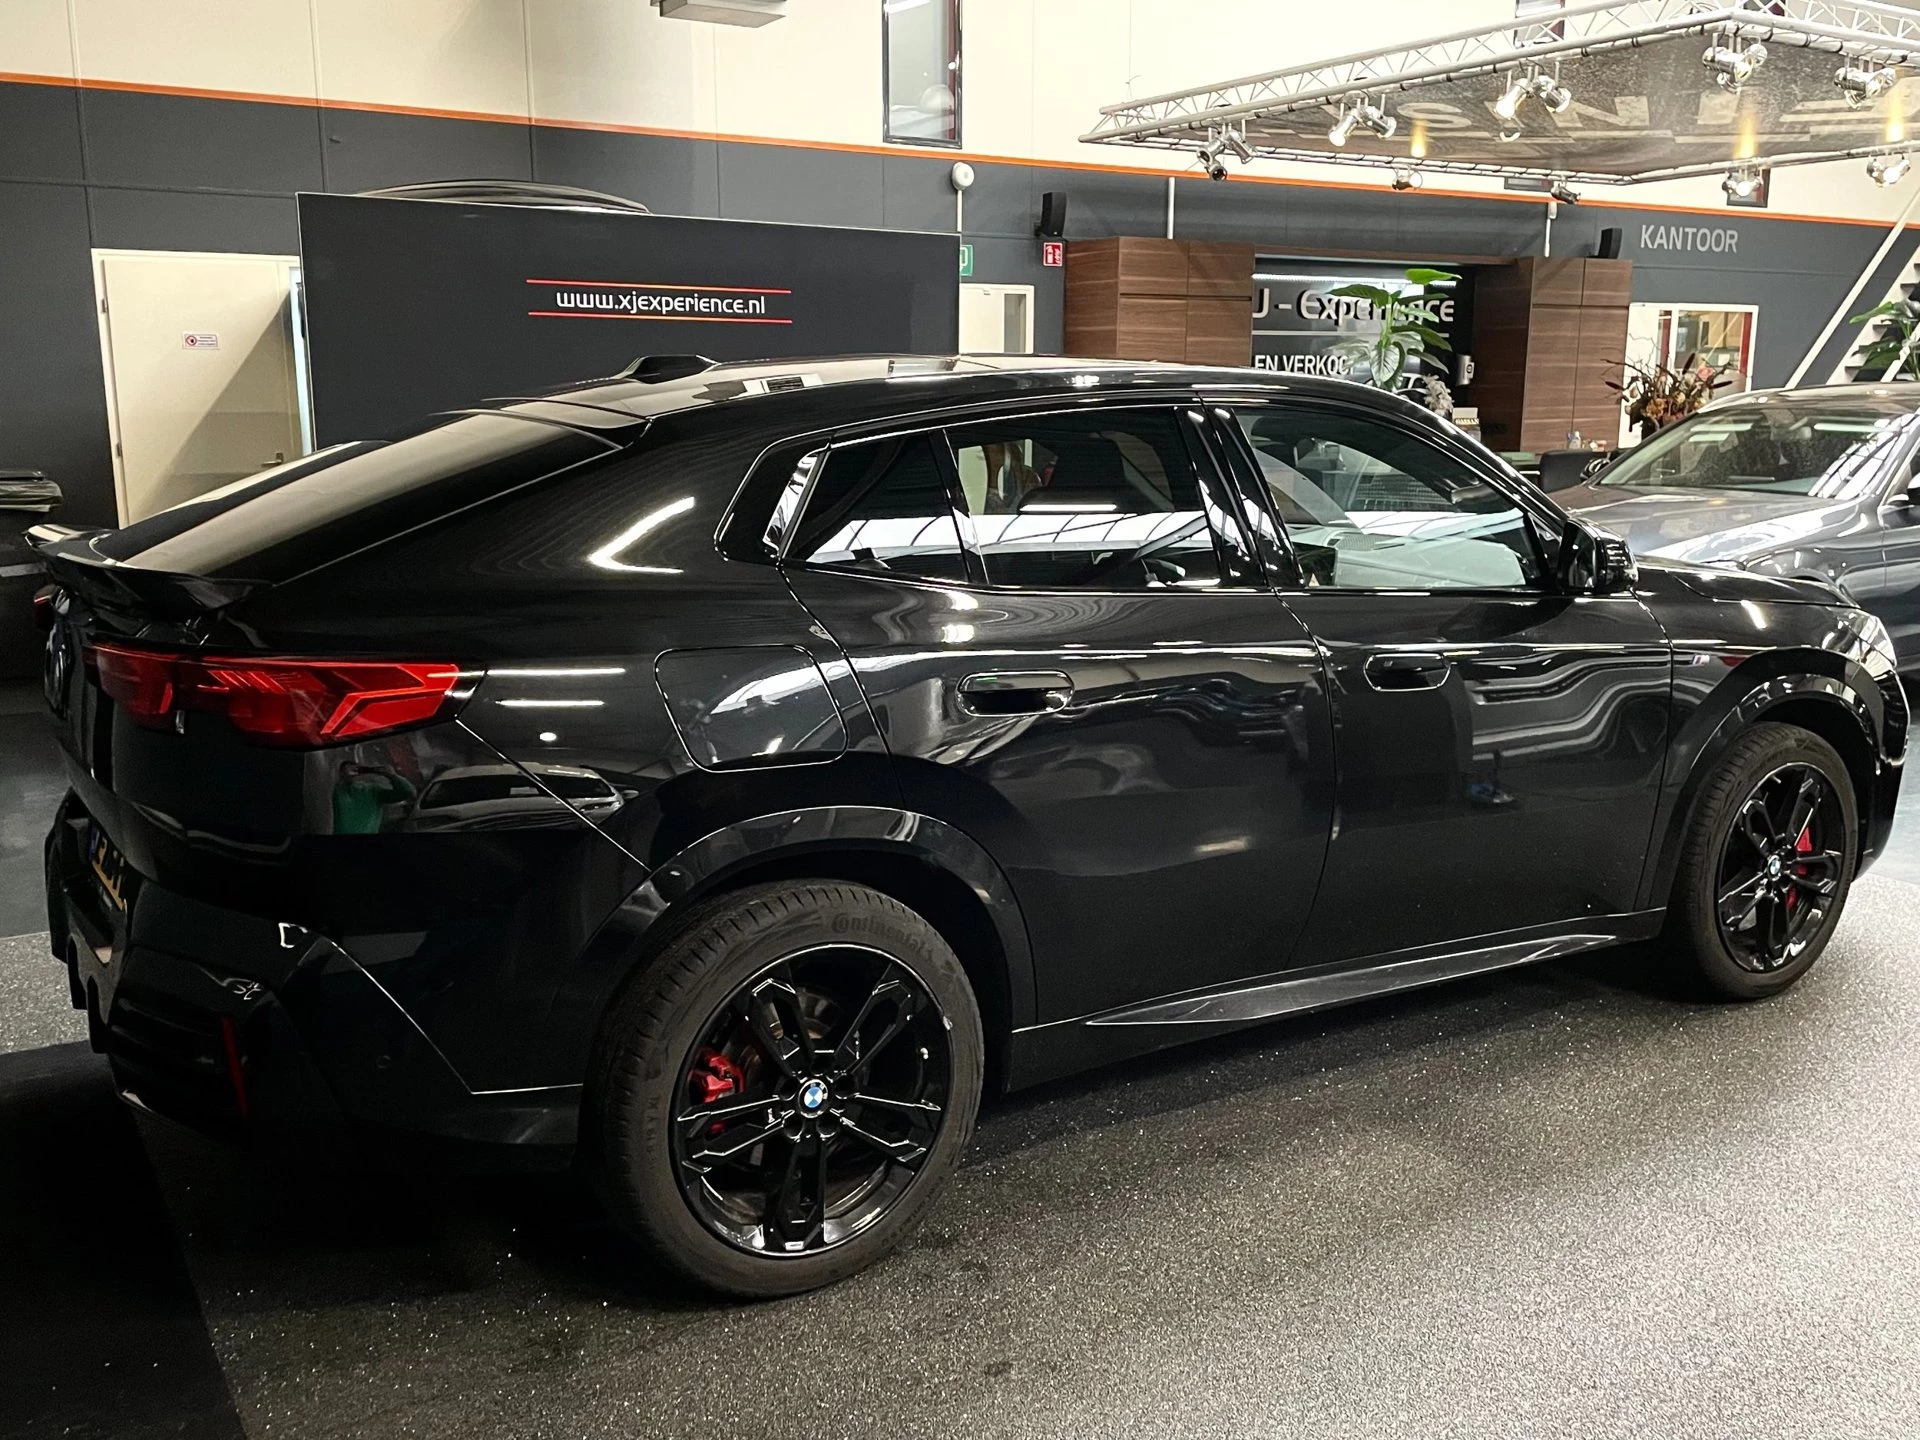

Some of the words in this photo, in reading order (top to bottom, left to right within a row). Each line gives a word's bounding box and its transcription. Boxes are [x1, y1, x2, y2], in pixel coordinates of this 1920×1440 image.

[1640, 224, 1738, 253] KANTOOR
[556, 291, 766, 315] www.xjexperience.nl
[1254, 354, 1279, 371] EN
[1282, 354, 1354, 376] VERKOO
